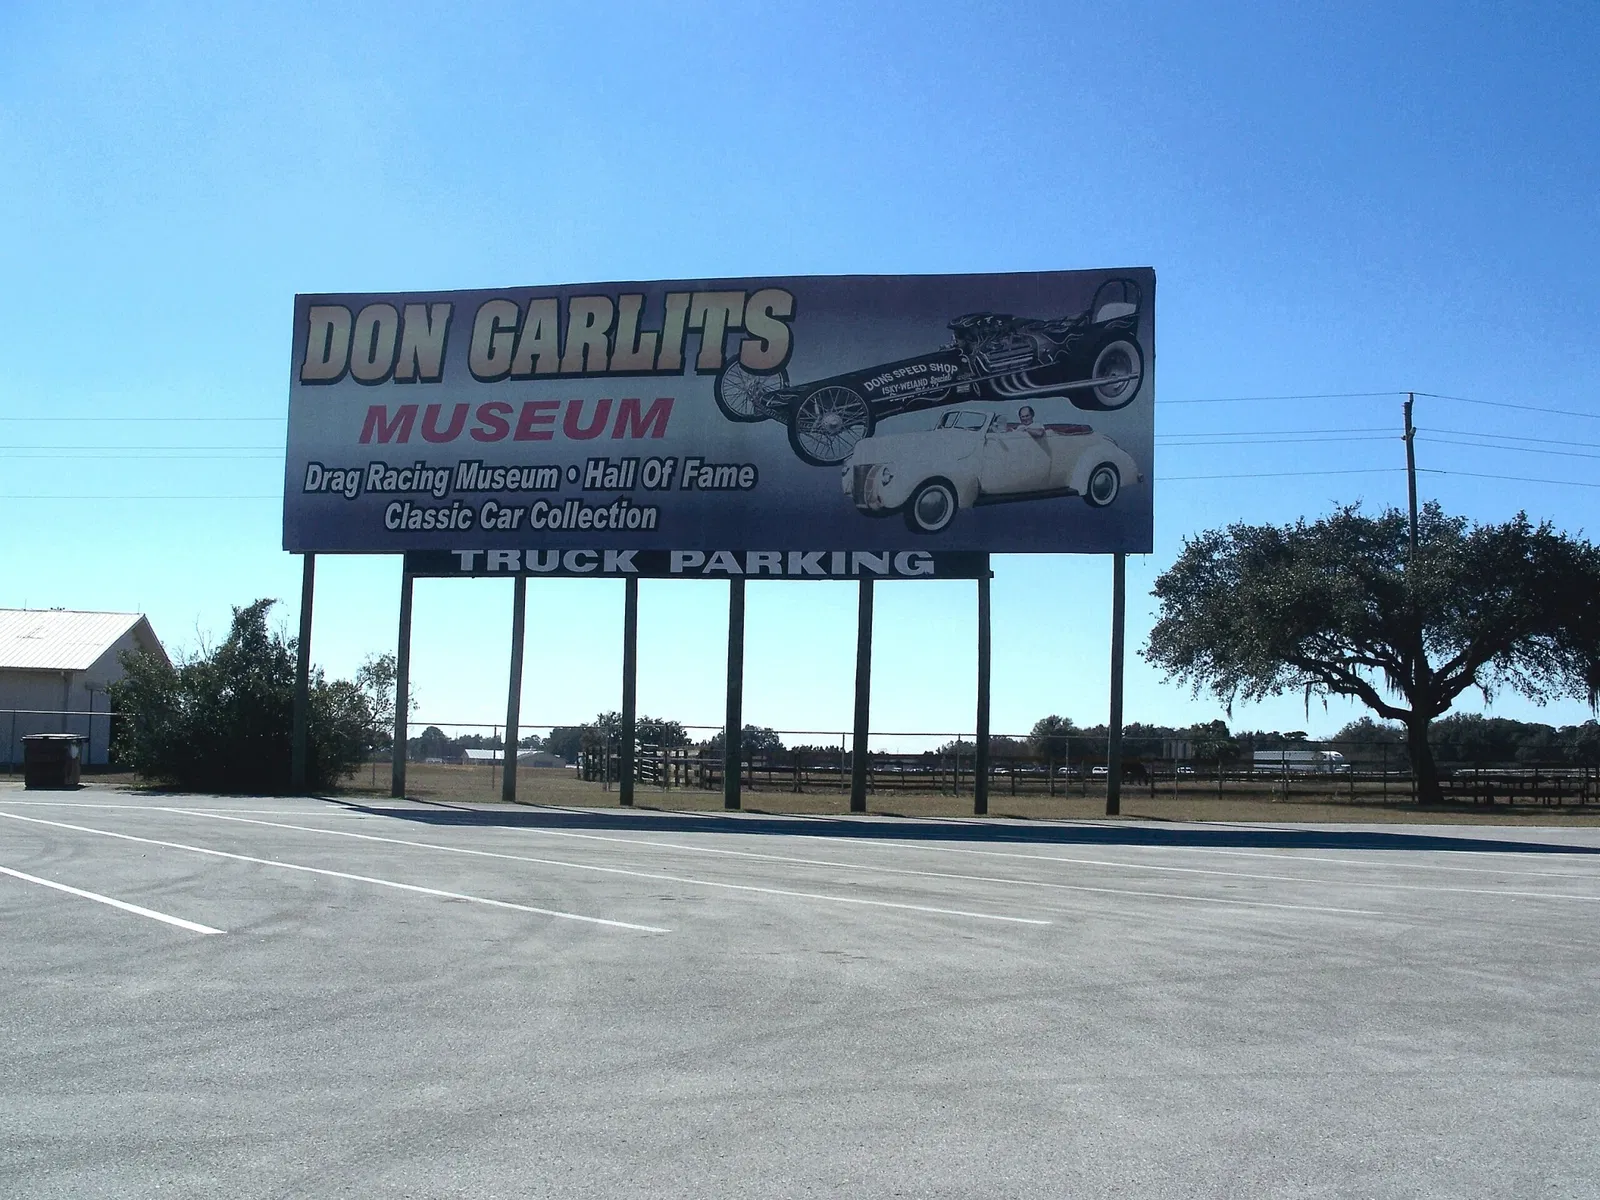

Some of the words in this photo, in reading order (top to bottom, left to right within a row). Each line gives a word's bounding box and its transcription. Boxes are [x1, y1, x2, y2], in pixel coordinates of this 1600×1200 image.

[300, 301, 452, 384] DON
[467, 288, 794, 380] GARLITS
[893, 364, 927, 379] SPEED
[929, 363, 958, 375] SHOP
[359, 398, 675, 444] MUSEUM
[304, 464, 361, 497] Drag
[366, 463, 449, 495] Racing
[455, 462, 558, 490] Museum
[584, 460, 637, 489] Hall
[643, 460, 674, 489] Of
[682, 459, 755, 488] Fame
[385, 501, 472, 530] Classic
[480, 502, 523, 530] Car
[530, 499, 657, 529] Collection
[451, 549, 639, 573] TRUCK
[670, 550, 935, 576] PARKING
